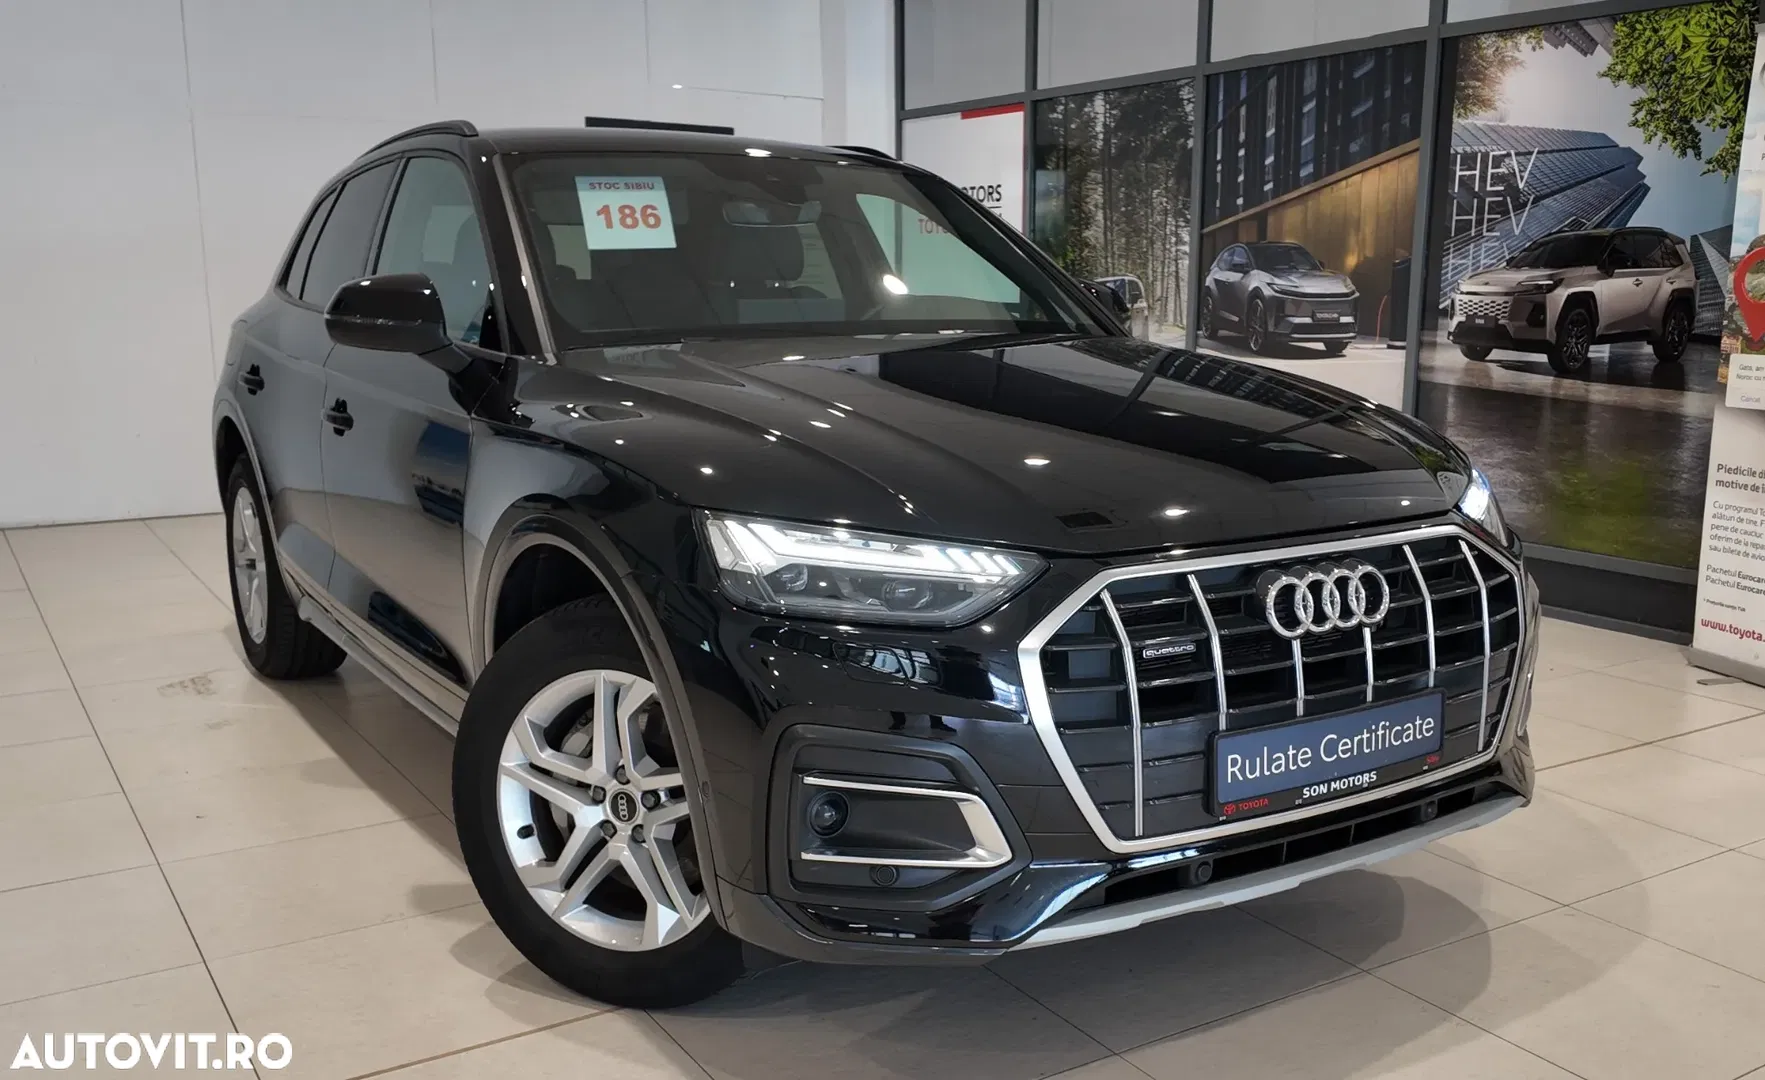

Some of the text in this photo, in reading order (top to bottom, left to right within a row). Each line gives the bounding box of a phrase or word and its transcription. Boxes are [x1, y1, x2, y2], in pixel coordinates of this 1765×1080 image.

[1455, 148, 1538, 192] HEV
[588, 182, 655, 190] STOC SIBIU
[596, 204, 662, 229] 186
[1451, 195, 1534, 236] HEV
[1716, 463, 1757, 478] Piedicile
[1715, 480, 1749, 491] motive
[1750, 482, 1760, 493] de
[1713, 500, 1724, 509] Cu
[1724, 504, 1758, 515] programul
[1710, 523, 1729, 532] pene
[1730, 525, 1739, 533] de
[1734, 537, 1743, 545] de
[1742, 550, 1750, 558] de
[1706, 564, 1737, 577] Pachetul
[1705, 574, 1736, 588] Pachetul
[1146, 644, 1194, 657] quattro
[1226, 715, 1435, 783] Rulate Certificate
[1302, 771, 1377, 799] SON MOTORS
[1239, 798, 1269, 811] TOYOTA
